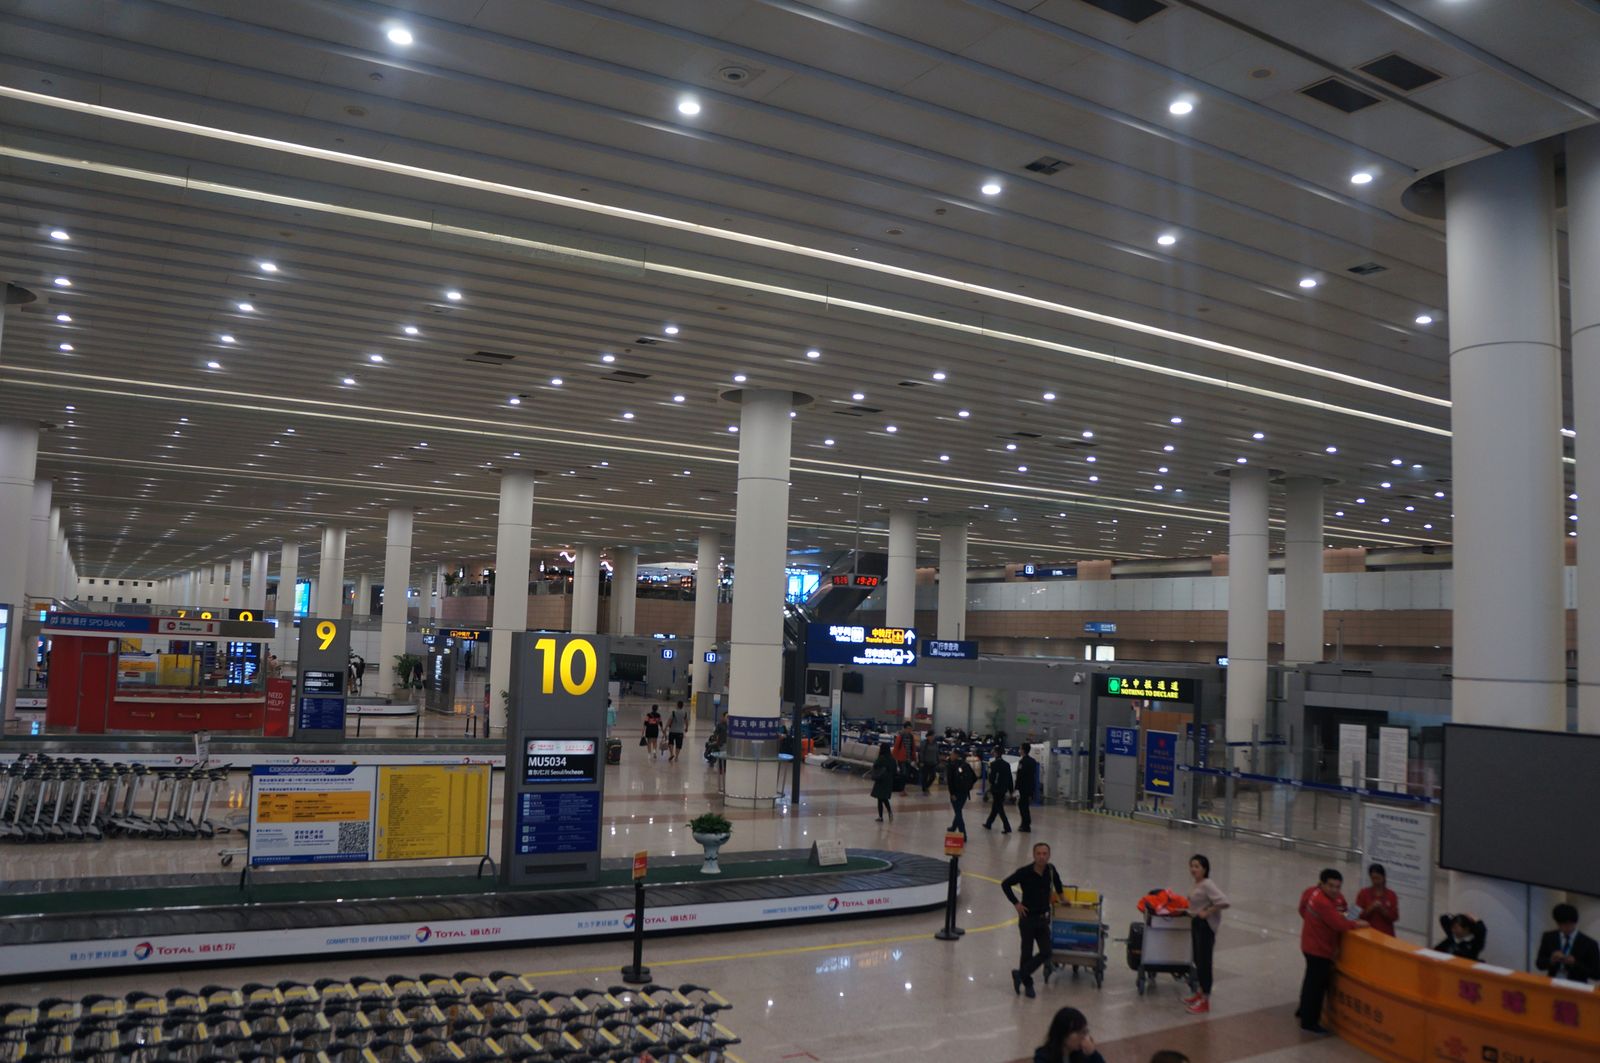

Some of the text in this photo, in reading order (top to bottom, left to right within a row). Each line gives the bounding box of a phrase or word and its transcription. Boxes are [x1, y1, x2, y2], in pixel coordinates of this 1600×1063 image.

[316, 621, 337, 650] 9
[534, 638, 597, 695] 10
[1121, 688, 1179, 699] NOTHING TO DECLARE
[528, 756, 567, 767] MU5034
[326, 934, 411, 945] COMMITTED TO BETTER ENERGY
[434, 929, 466, 939] TOTAL
[157, 945, 195, 955] TOTAL
